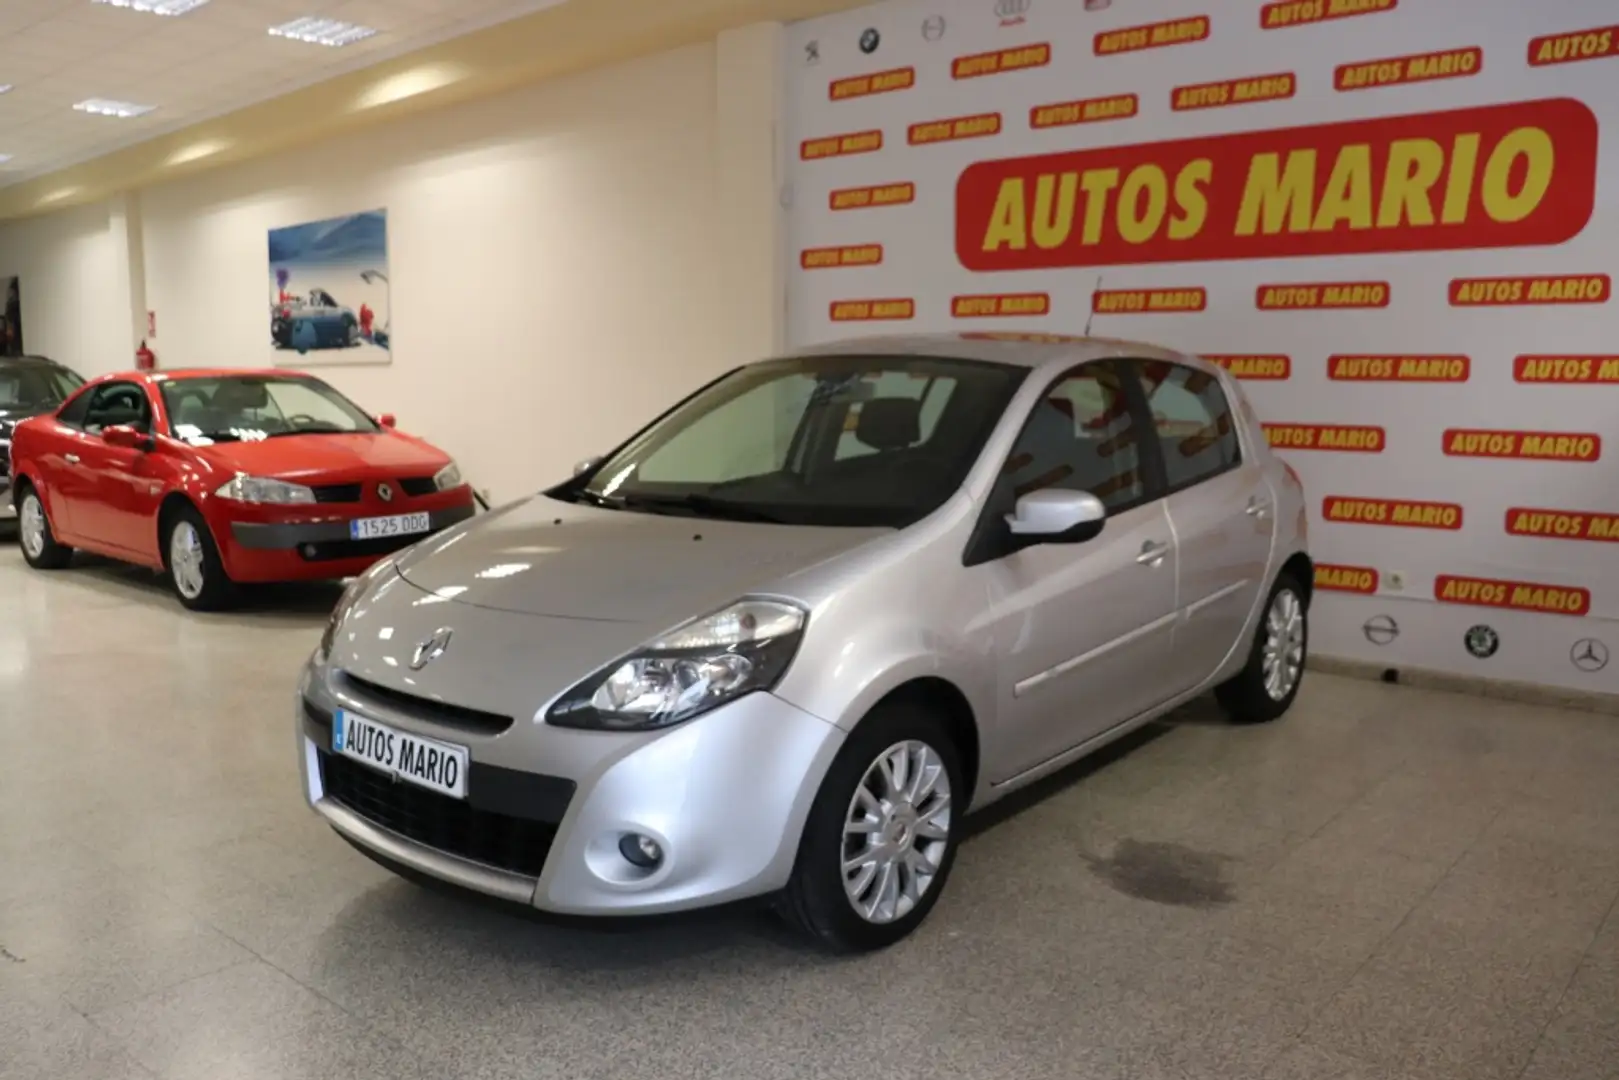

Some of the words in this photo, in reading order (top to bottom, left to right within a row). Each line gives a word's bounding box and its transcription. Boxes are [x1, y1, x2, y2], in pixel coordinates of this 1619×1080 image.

[1267, 0, 1324, 25] AUTOS
[1100, 29, 1147, 51] AUTOS
[1151, 19, 1206, 43] MARIO
[1537, 32, 1611, 60] AUTOS
[956, 55, 997, 76] AUTOS
[1000, 46, 1047, 69] MARIO
[1341, 61, 1402, 87] AUTOS
[1407, 52, 1476, 78] MARIO
[1177, 86, 1229, 107] AUTOS
[1233, 76, 1291, 100] MARIO
[1035, 105, 1079, 126] AUTOS
[1083, 97, 1134, 120] MARIO
[912, 123, 952, 142] AUTOS
[982, 159, 1213, 252] AUTOS
[1234, 126, 1555, 236] MARIO
[1098, 292, 1146, 311] AUTOS
[1148, 290, 1202, 309] MARIO
[1264, 287, 1317, 306] AUTOS
[1322, 285, 1385, 305] MARIO
[1456, 280, 1524, 303] AUTOS
[1528, 278, 1603, 300] MARIO
[955, 297, 997, 316] AUTOS
[1000, 295, 1046, 314] MARIO
[1228, 358, 1285, 376] MARIO
[1335, 359, 1393, 377] AUTOS
[1398, 358, 1465, 378] MARIO
[1522, 359, 1592, 380] AUTOS
[1318, 429, 1380, 449] MARIO
[1451, 433, 1516, 455] AUTOS
[1520, 435, 1594, 458] MARIO
[1330, 501, 1387, 521] AUTOS
[1391, 504, 1457, 526] MARIO
[1513, 513, 1583, 535] AUTOS
[363, 518, 398, 536] 1525
[1315, 567, 1372, 589] MARIO
[1442, 581, 1507, 603] AUTOS
[1511, 586, 1582, 611] MARIO
[346, 719, 394, 766] AUTOS
[398, 738, 458, 788] MARIO
